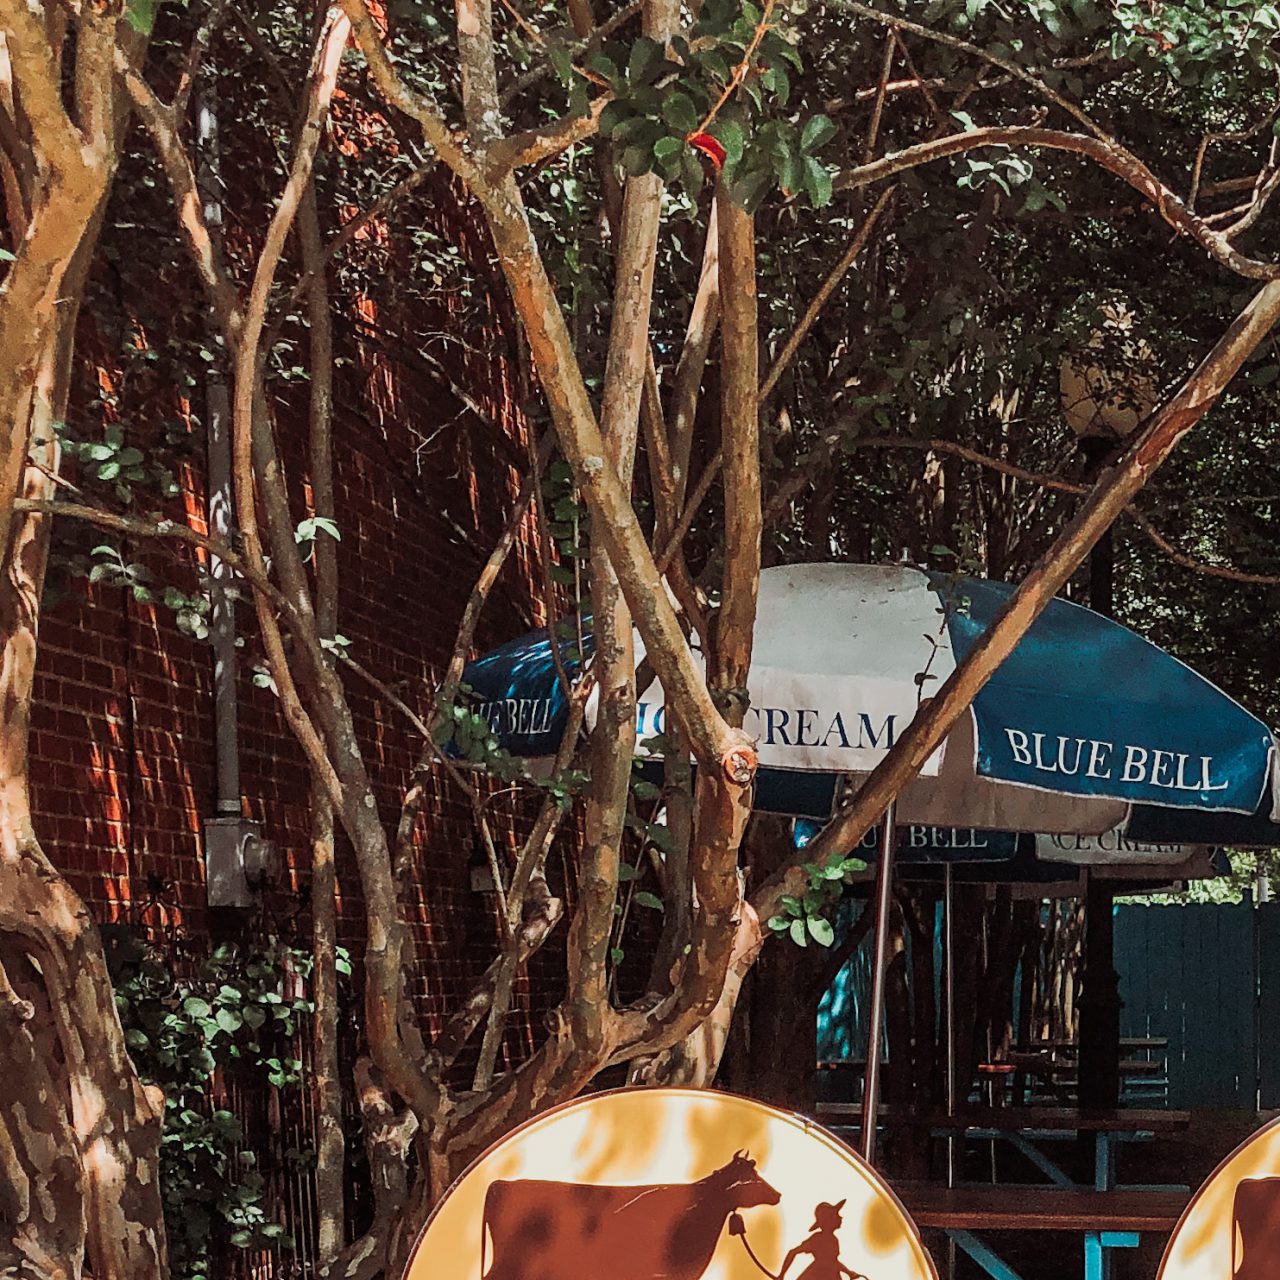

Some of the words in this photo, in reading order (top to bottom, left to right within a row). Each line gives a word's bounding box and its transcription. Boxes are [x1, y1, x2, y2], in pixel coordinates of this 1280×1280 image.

[505, 698, 552, 734] BELL
[1004, 728, 1112, 779] BLUE
[1120, 745, 1229, 791] BELL
[909, 824, 988, 849] BELL
